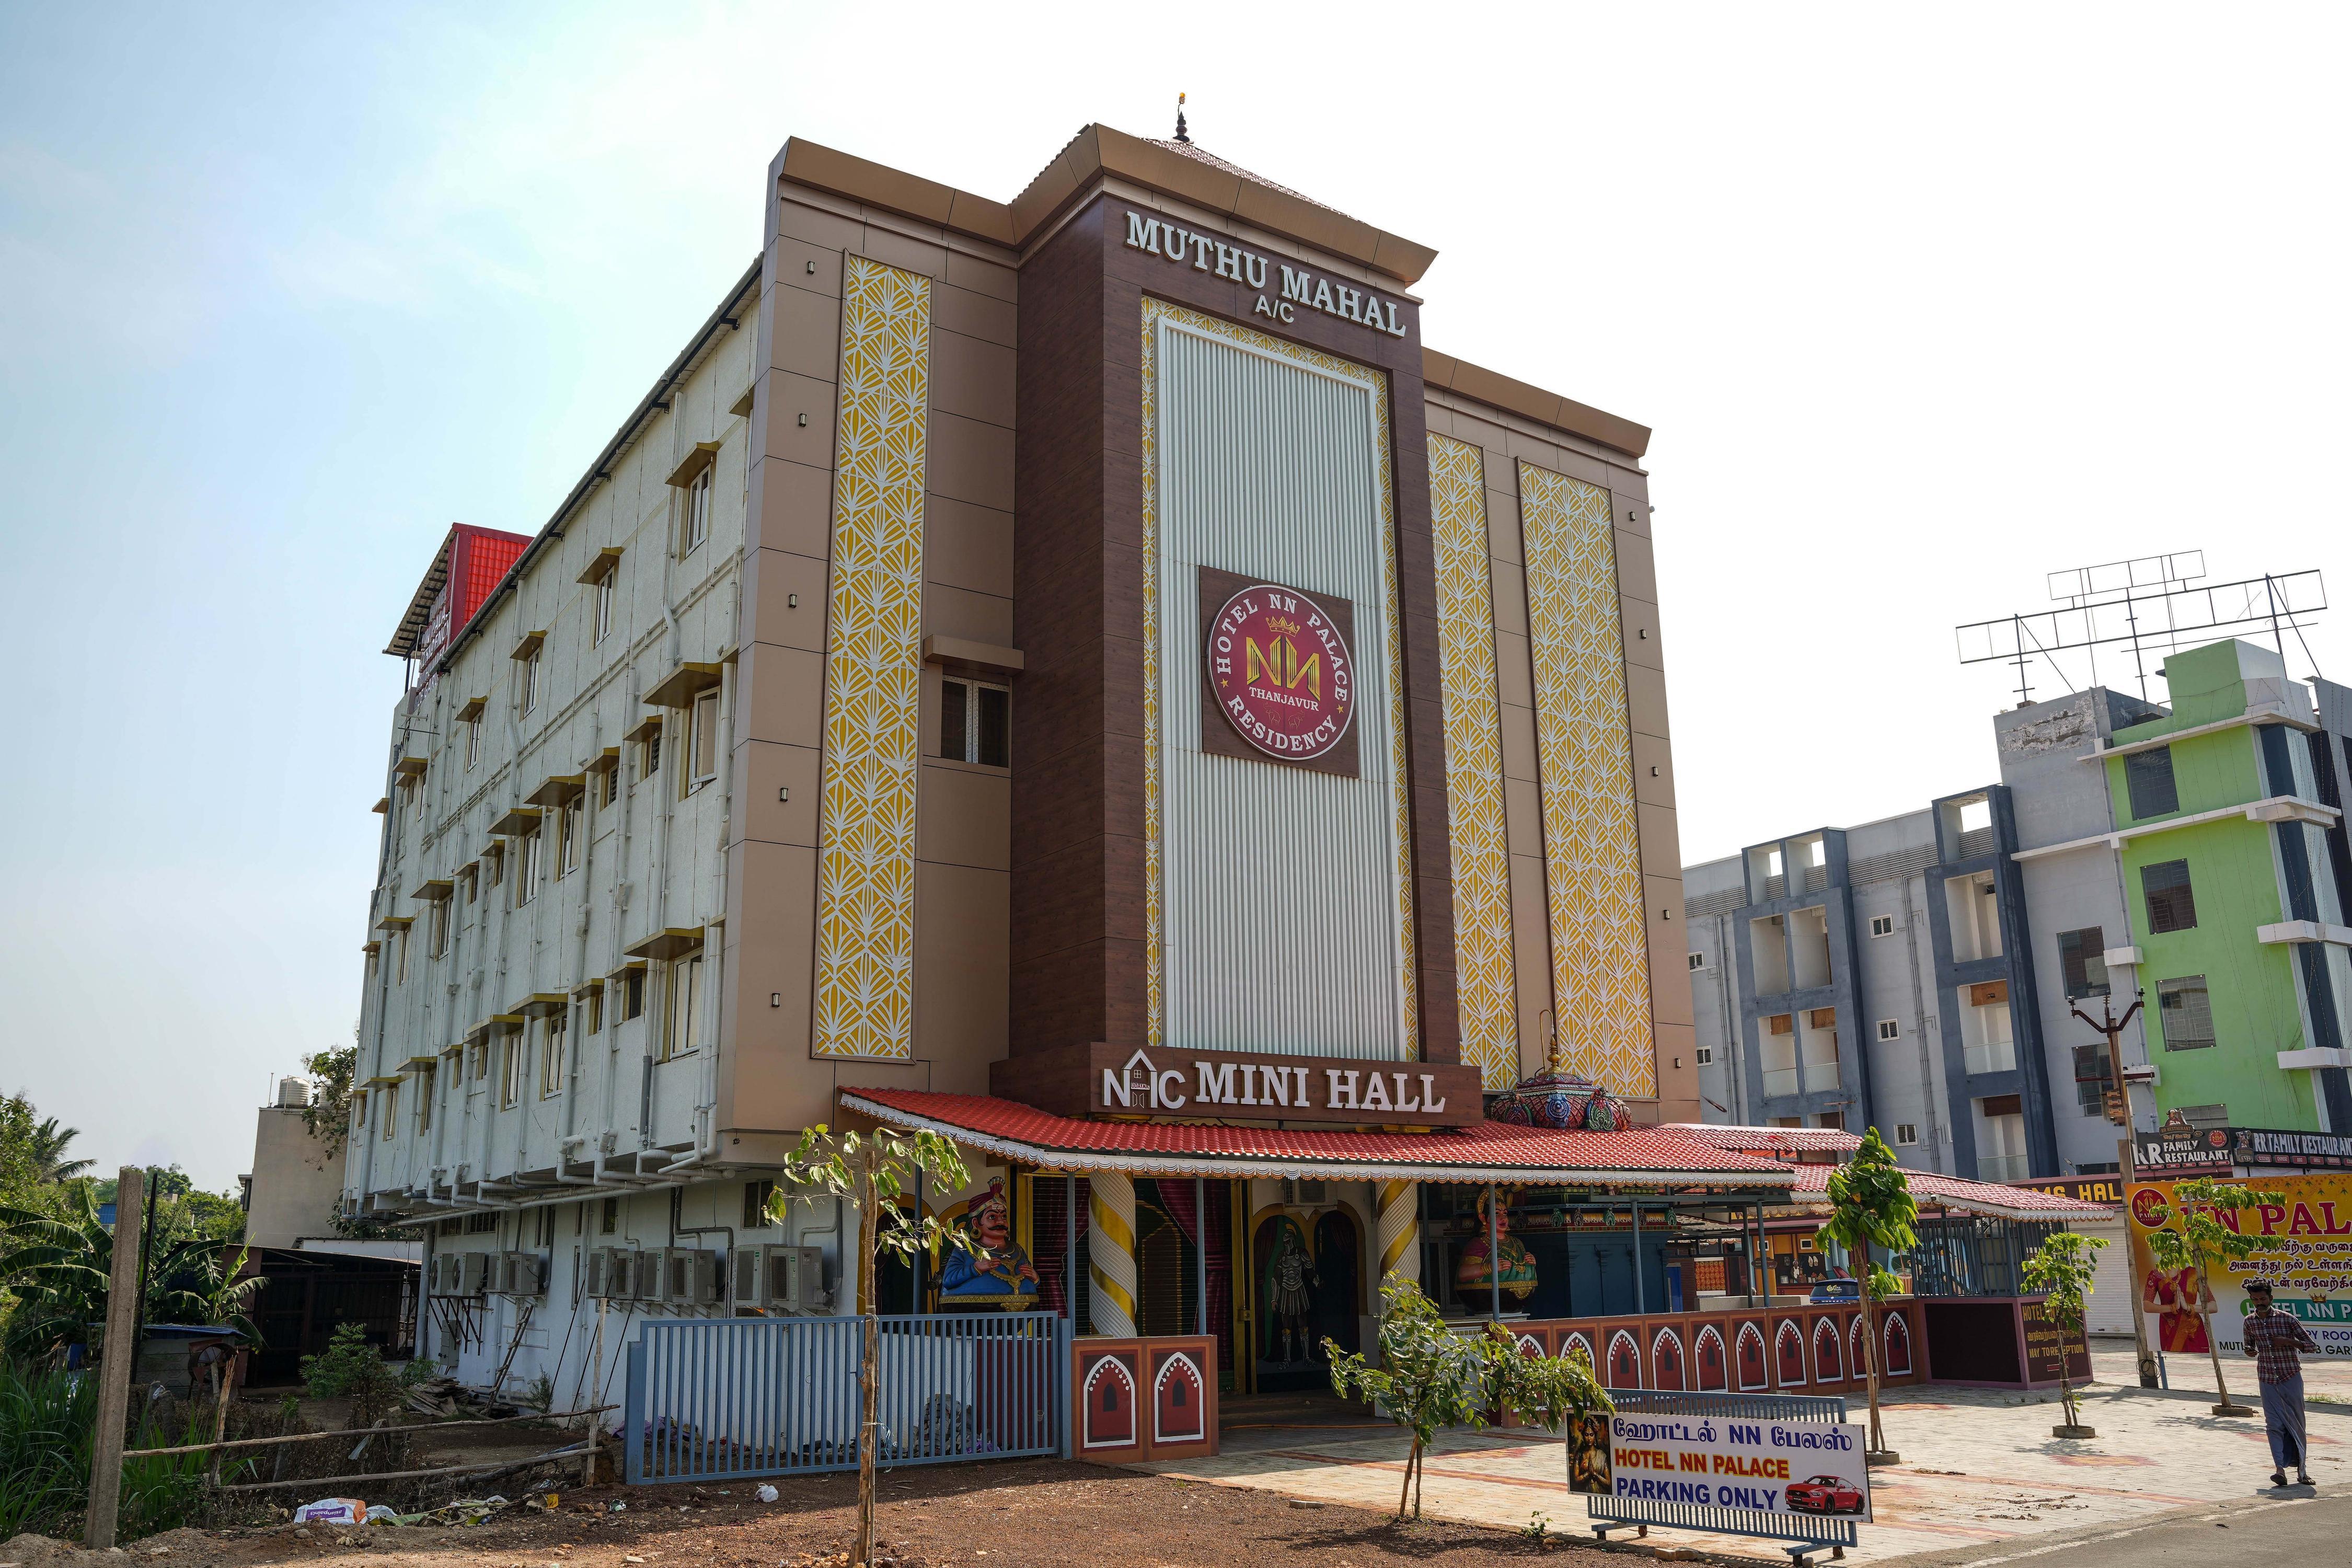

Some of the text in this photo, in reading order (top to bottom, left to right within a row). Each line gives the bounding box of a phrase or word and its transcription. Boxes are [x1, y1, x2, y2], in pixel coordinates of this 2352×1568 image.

[1125, 210, 1406, 338] MUTHU MAHAL
[1255, 294, 1295, 325] A/C
[1217, 593, 1348, 701] HOTEL NN PALACE
[1249, 686, 1320, 711] THANJAVUR
[1228, 695, 1337, 752] RESIDENCY
[1193, 1061, 1309, 1108] MINI
[1325, 1068, 1446, 1113] HALL
[2163, 1140, 2198, 1152] FAMILY
[2253, 1133, 2267, 1152] RR
[2267, 1133, 2300, 1154] FAMILY
[2164, 1150, 2229, 1163] RESTAURANT
[2078, 1183, 2122, 1202] HAL
[2255, 1202, 2352, 1236] PAL
[2228, 1259, 2281, 1274] அனைத்து
[2284, 1258, 2304, 1274] நல்
[2294, 1275, 2352, 1293] வரவேற்கி
[2022, 1305, 2043, 1321] HOTEL
[2246, 1301, 2301, 1318] HTEL
[2307, 1302, 2335, 1319] NN
[2322, 1330, 2352, 1341] ROO
[2042, 1347, 2050, 1357] TO
[2050, 1344, 2084, 1356] REEPTION
[2325, 1345, 2352, 1355] GAR
[1613, 1417, 1852, 1451] ஹோட்டல் NN பேலஸ்
[1614, 1447, 1791, 1480] HOTEL NN PALACE
[1616, 1477, 1778, 1510] PARKING ONLY
